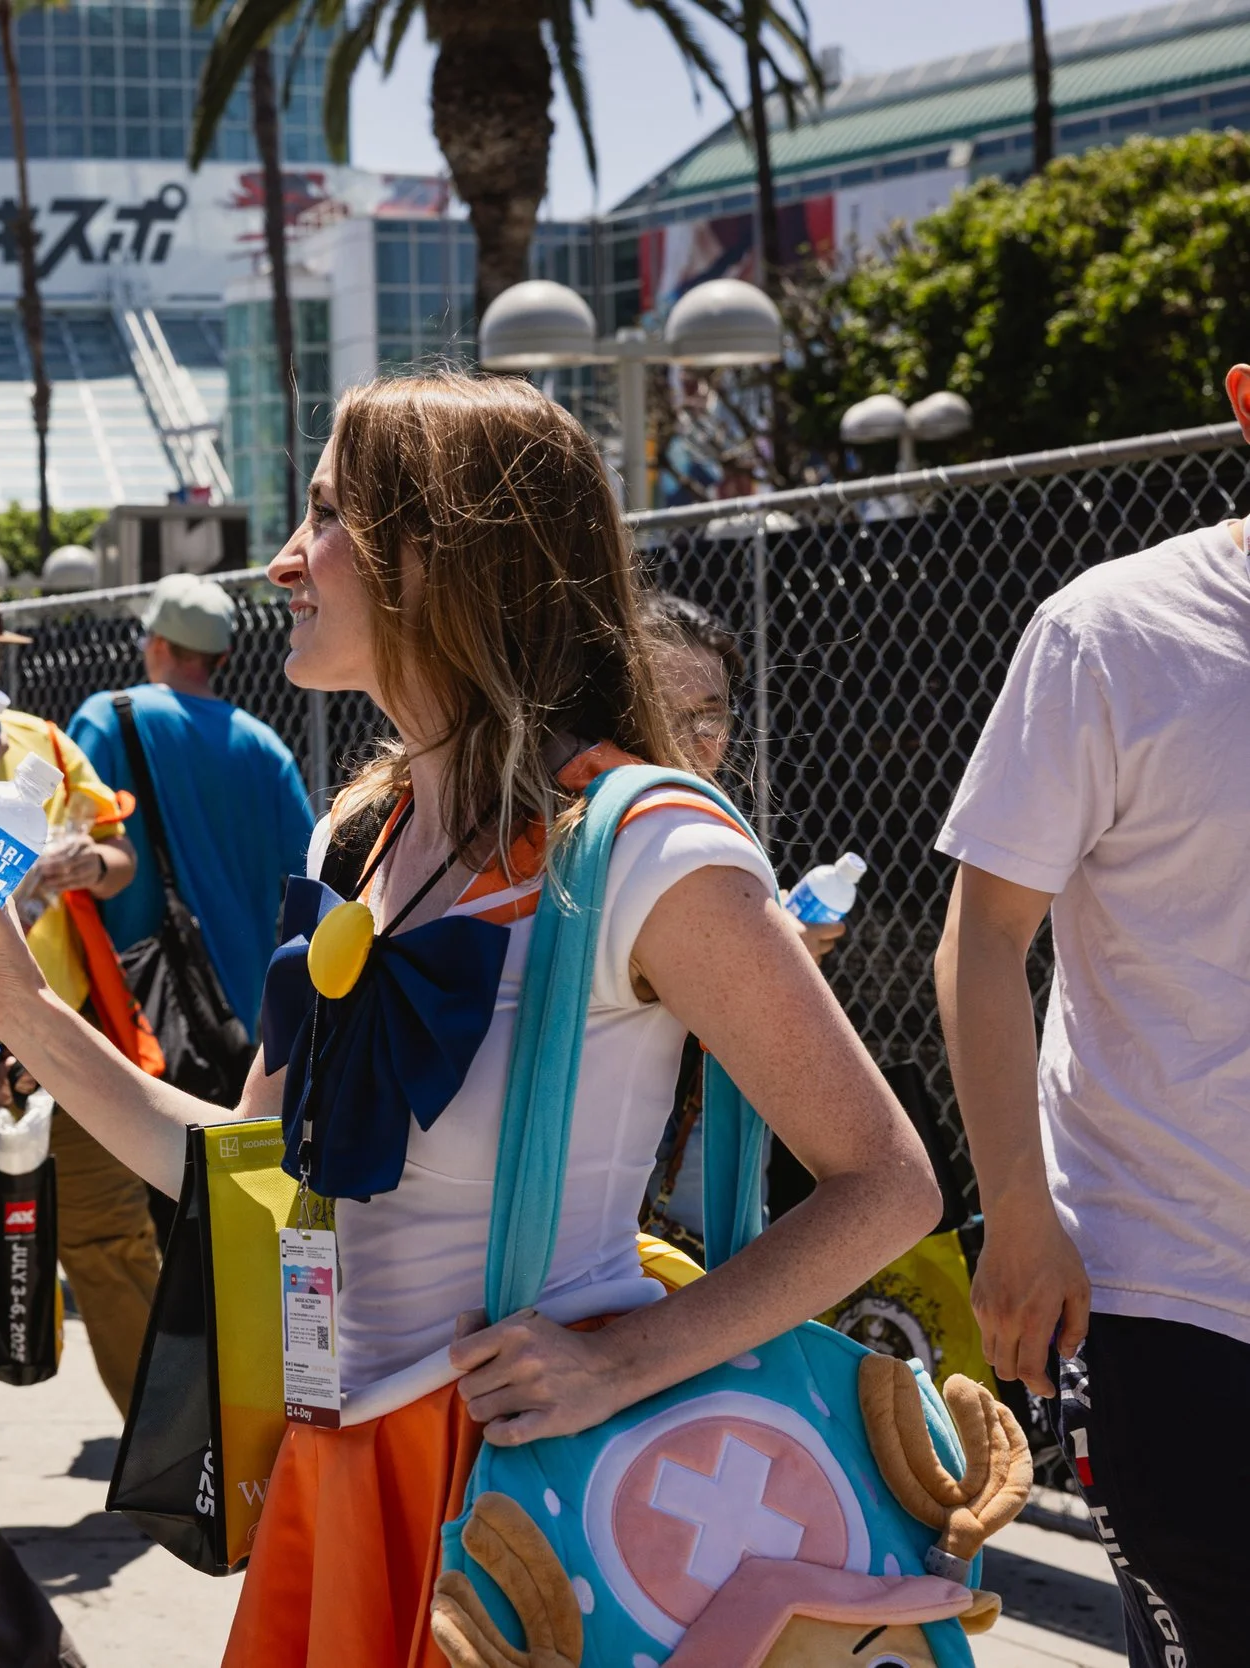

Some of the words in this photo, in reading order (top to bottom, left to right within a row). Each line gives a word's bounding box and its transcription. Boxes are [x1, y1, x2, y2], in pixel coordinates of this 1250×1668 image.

[242, 1137, 284, 1149] KODANSH
[6, 1208, 36, 1225] AX
[11, 1243, 29, 1279] JULY
[9, 1285, 27, 1320] 3-6,
[293, 1406, 312, 1421] 4-Day
